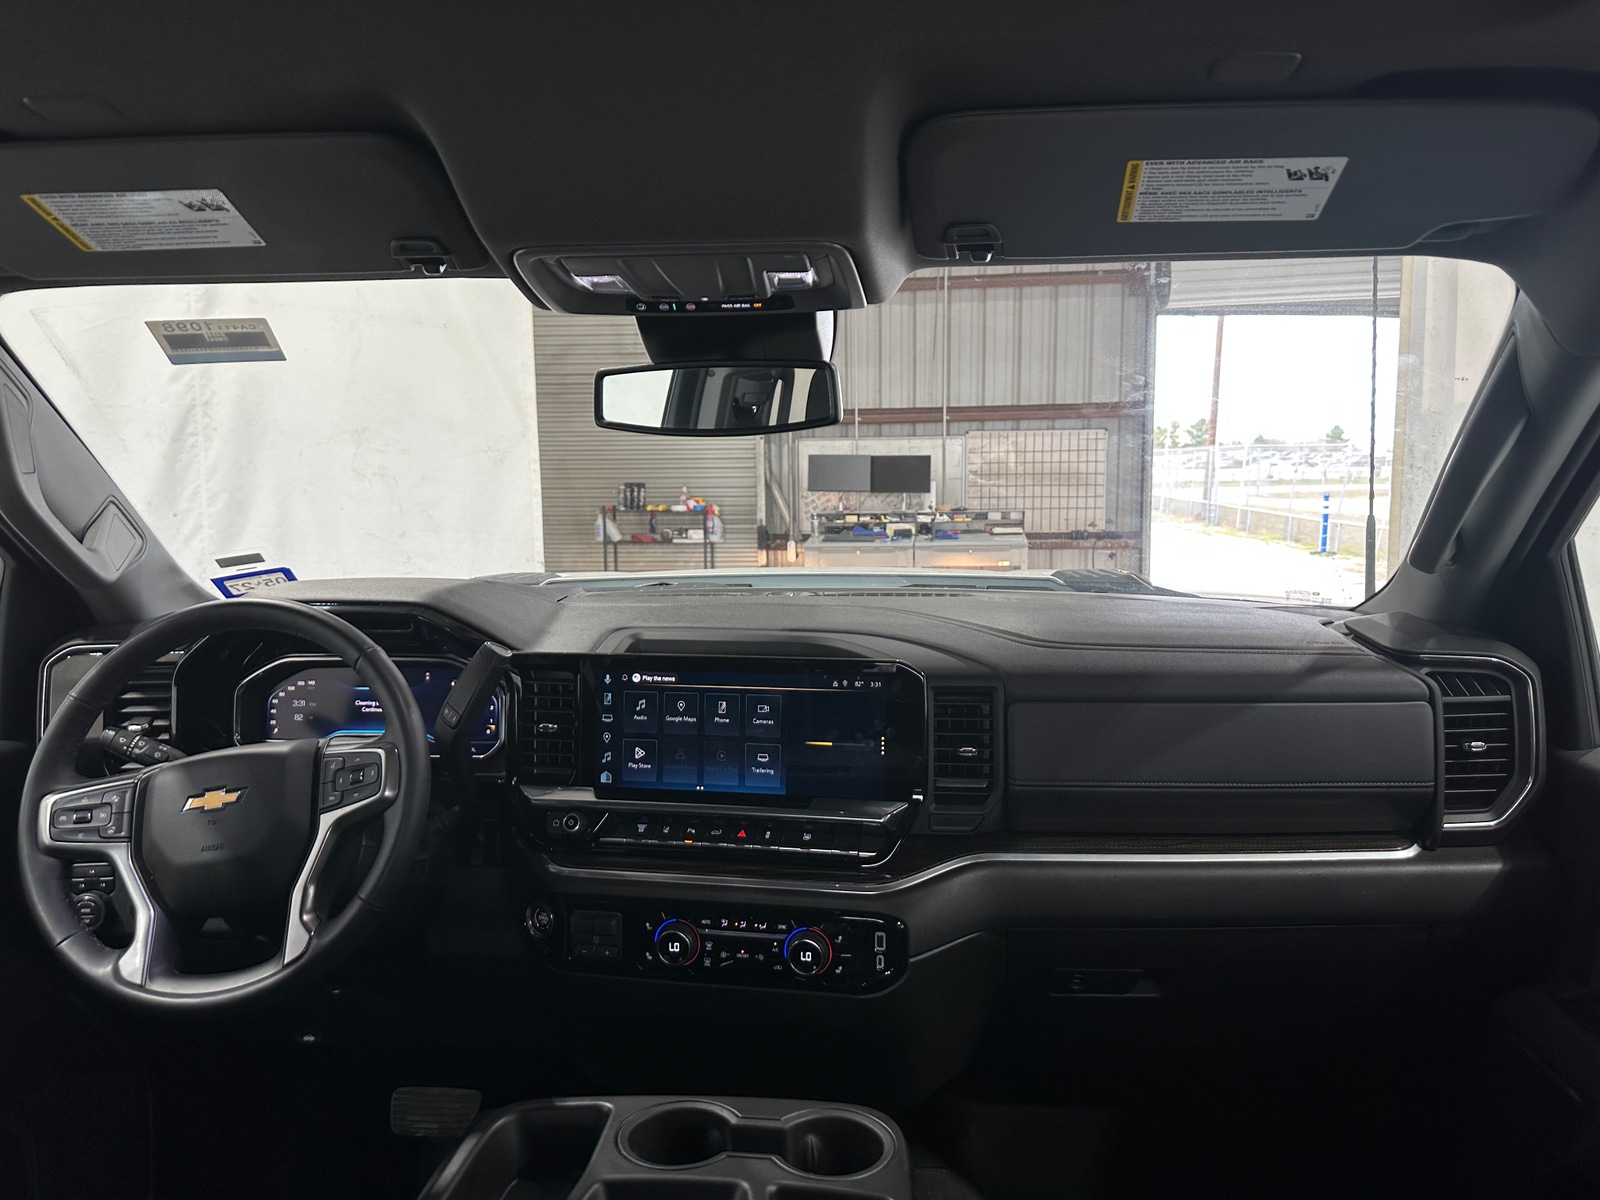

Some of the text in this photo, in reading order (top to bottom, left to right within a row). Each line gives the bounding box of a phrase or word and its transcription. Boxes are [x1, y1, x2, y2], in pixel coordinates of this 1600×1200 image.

[642, 675, 652, 683] Play
[292, 699, 306, 707] 3:31
[355, 699, 375, 707] Cleaning
[294, 713, 304, 721] 82
[665, 715, 682, 723] Google
[752, 717, 775, 725] Cameras
[627, 762, 638, 770] Play
[752, 766, 775, 775] Trailering
